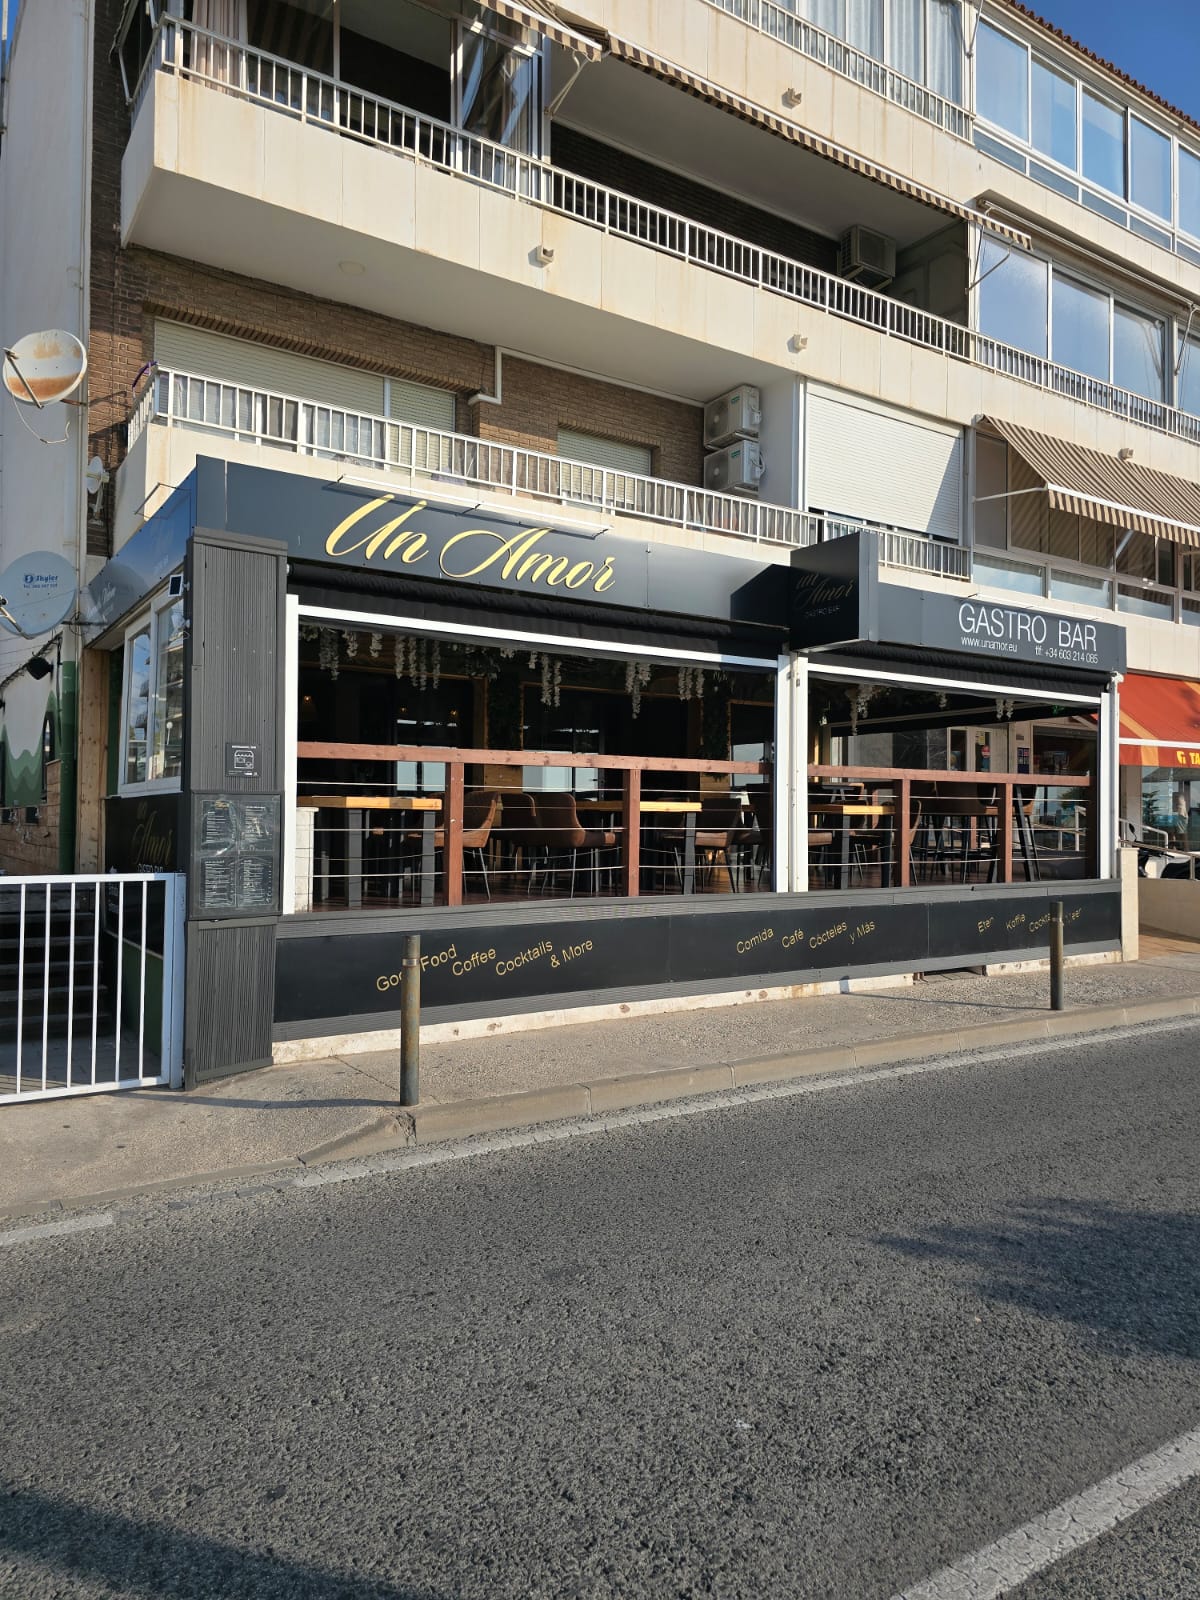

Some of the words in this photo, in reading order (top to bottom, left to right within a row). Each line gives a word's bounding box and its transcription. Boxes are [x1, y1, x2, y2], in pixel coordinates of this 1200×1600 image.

[325, 494, 428, 563] Un
[439, 526, 616, 592] Amor
[958, 602, 1047, 644] GASTRO
[1058, 619, 1097, 652] BAR
[736, 927, 775, 954] Comida
[781, 928, 805, 948] Café
[849, 932, 856, 945] y
[376, 971, 402, 991] Go
[421, 943, 457, 972] Food
[452, 947, 496, 976] Coffee
[495, 940, 553, 976] Cocktails
[550, 954, 561, 969] &
[562, 939, 594, 963] More
